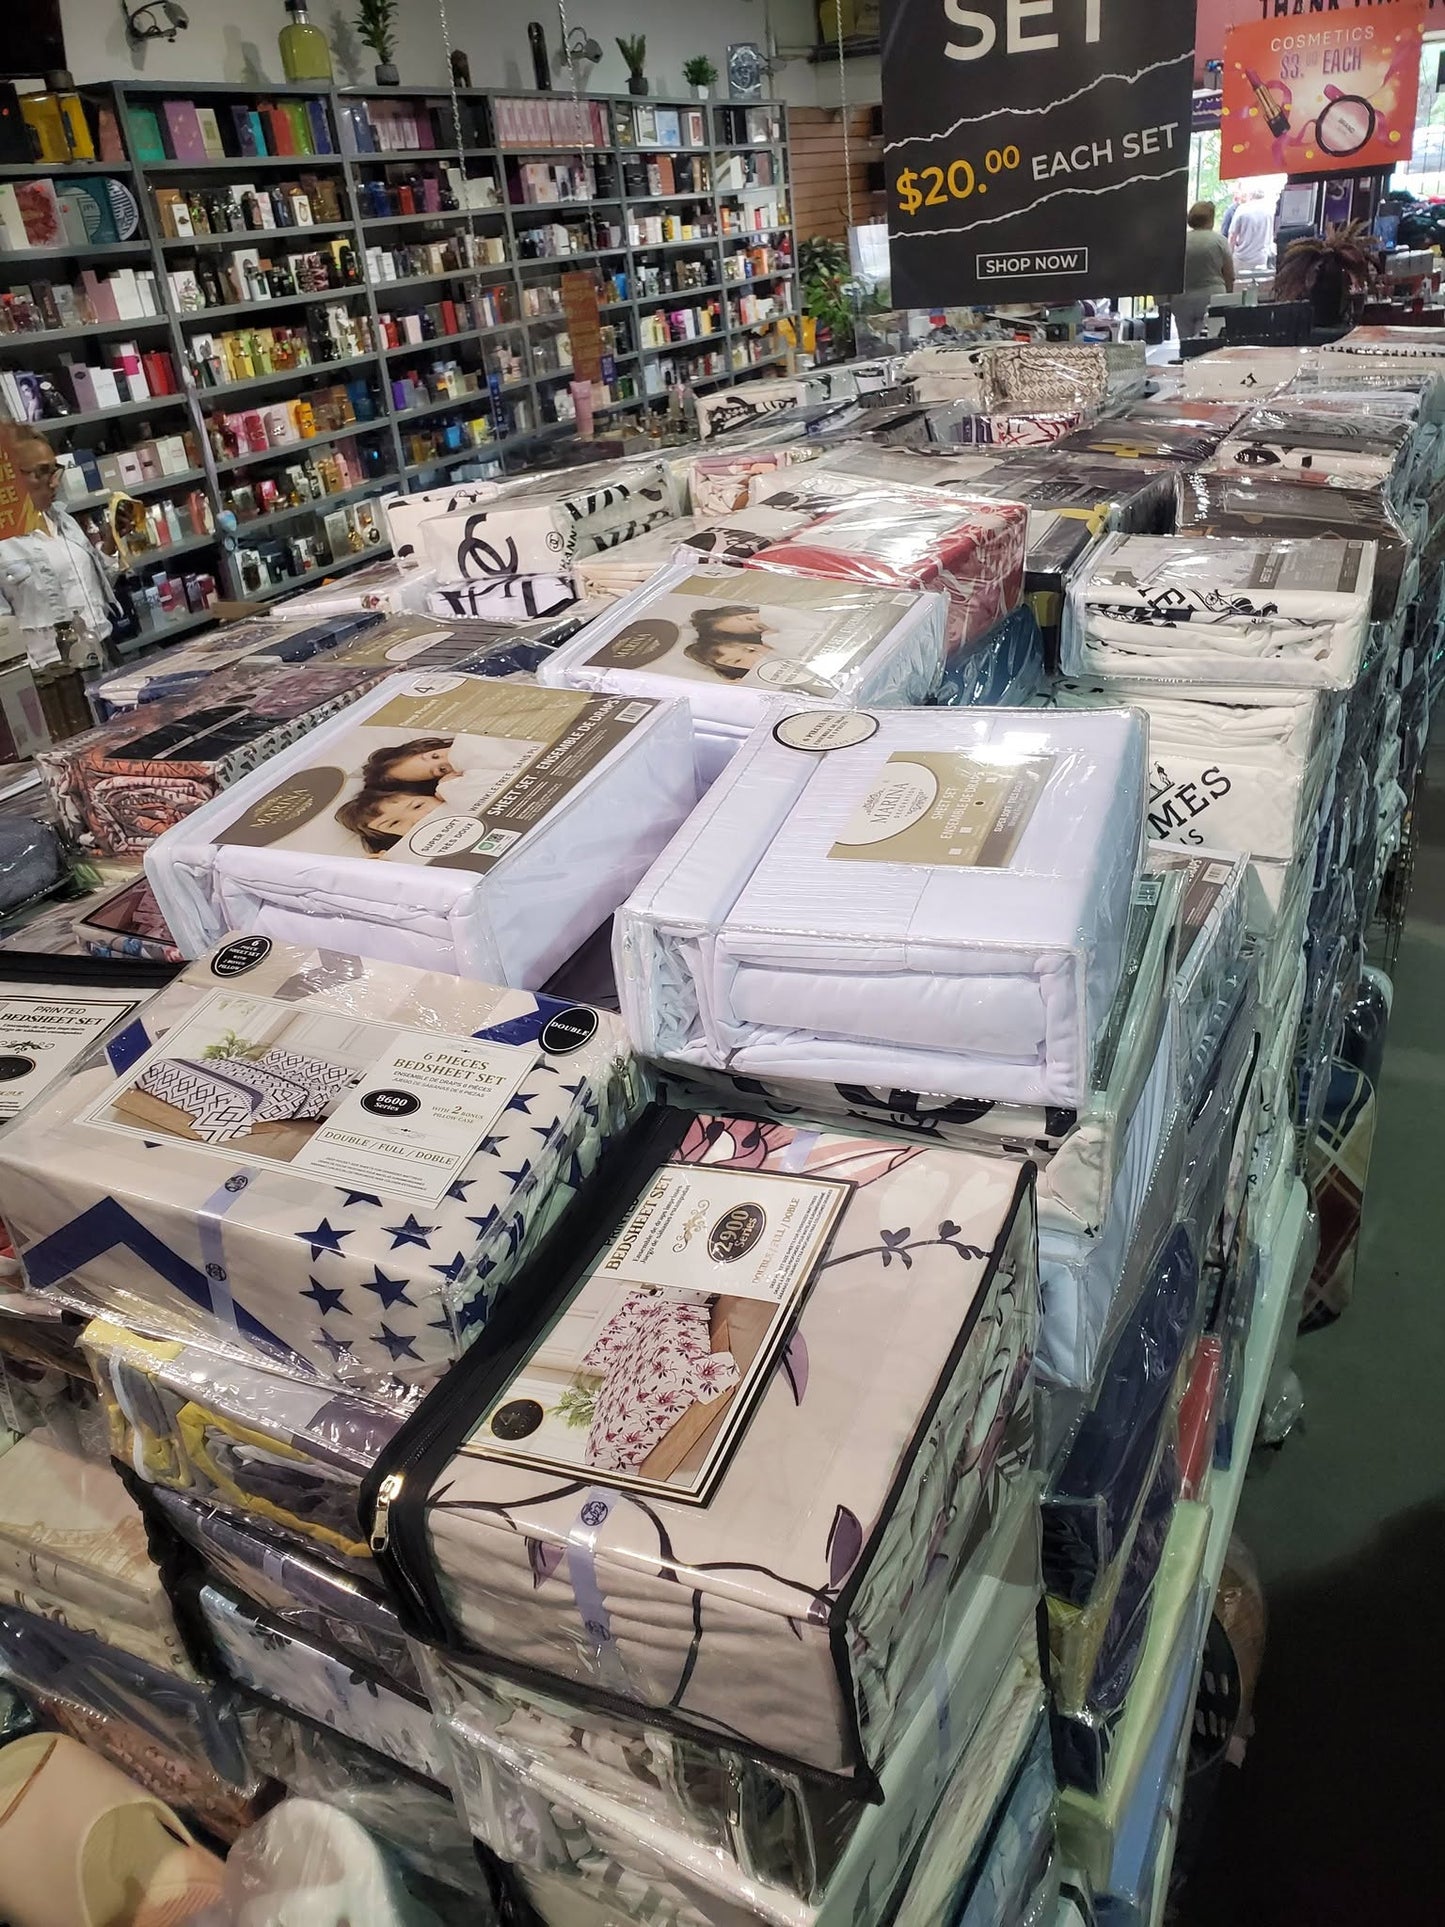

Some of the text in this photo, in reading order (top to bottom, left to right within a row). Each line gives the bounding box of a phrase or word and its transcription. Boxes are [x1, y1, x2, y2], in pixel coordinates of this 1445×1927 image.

[1271, 26, 1375, 52] COSMETICS
[1322, 46, 1362, 75] EACH
[896, 122, 1179, 216] $20.00 EACH SET
[985, 253, 1079, 274] SHOP NOW
[487, 789, 522, 817] SHEET
[516, 774, 539, 792] SET
[535, 731, 585, 771] ENSEMBLE
[578, 720, 597, 733] DE
[592, 698, 622, 722] DRAPS
[250, 788, 309, 828] MARINA
[467, 786, 498, 813] WRINKLE
[870, 782, 910, 824] MARINA
[931, 786, 960, 820] SHEET SET
[454, 822, 475, 839] DOUX
[939, 801, 967, 839] ENSEMBLE
[421, 818, 461, 852] SUPER SOFT
[251, 939, 262, 947] 6
[0, 1013, 106, 1027] BEDSHEET SET
[33, 1005, 87, 1015] PRINTED
[551, 1021, 590, 1037] DOUBLE
[393, 1058, 507, 1087] BEDSHEET SET
[423, 1052, 490, 1071] 6 PIECES
[393, 1070, 429, 1082] ENSEMBLE
[439, 1078, 463, 1088] DRAPS
[373, 1102, 401, 1112] Series
[376, 1094, 409, 1108] 8600
[432, 1112, 457, 1121] PILLOW
[461, 1112, 485, 1121] BONUS
[324, 1130, 370, 1147] DOUBLE
[378, 1143, 405, 1155] FULL
[415, 1151, 455, 1166] DOBLE
[604, 1174, 674, 1271] BEDSHEET SET
[783, 1197, 801, 1223] DOBLE
[719, 1209, 750, 1253] 2900
[734, 1216, 758, 1248] Series
